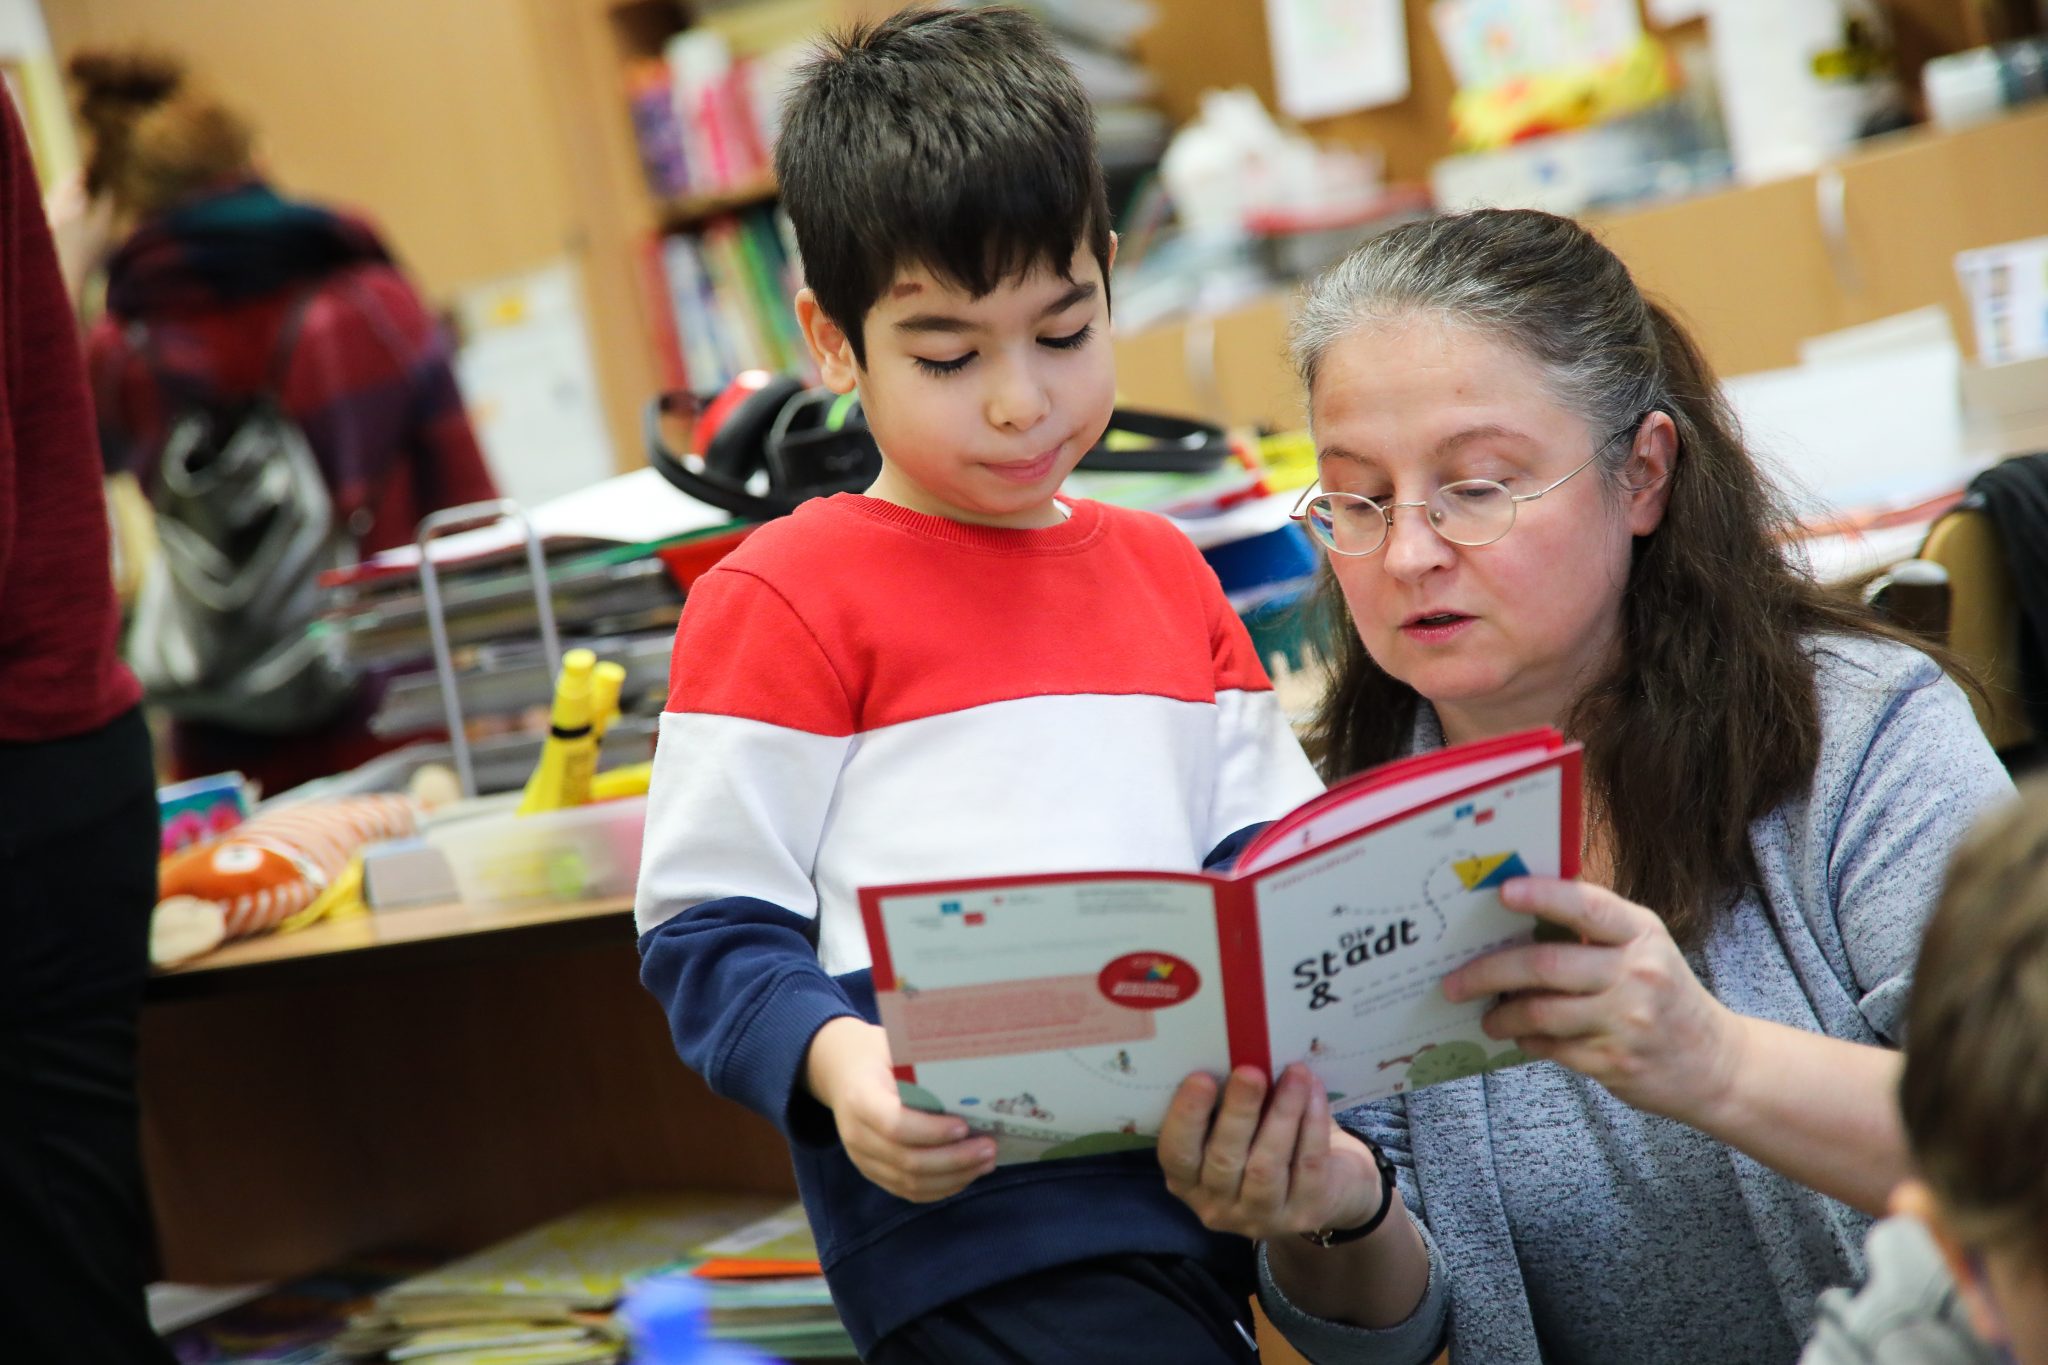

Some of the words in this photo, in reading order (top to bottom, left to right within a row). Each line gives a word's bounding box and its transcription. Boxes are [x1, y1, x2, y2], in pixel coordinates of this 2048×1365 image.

[1340, 926, 1375, 949] Die
[1293, 918, 1420, 990] Stadt
[1308, 981, 1341, 1011] &
